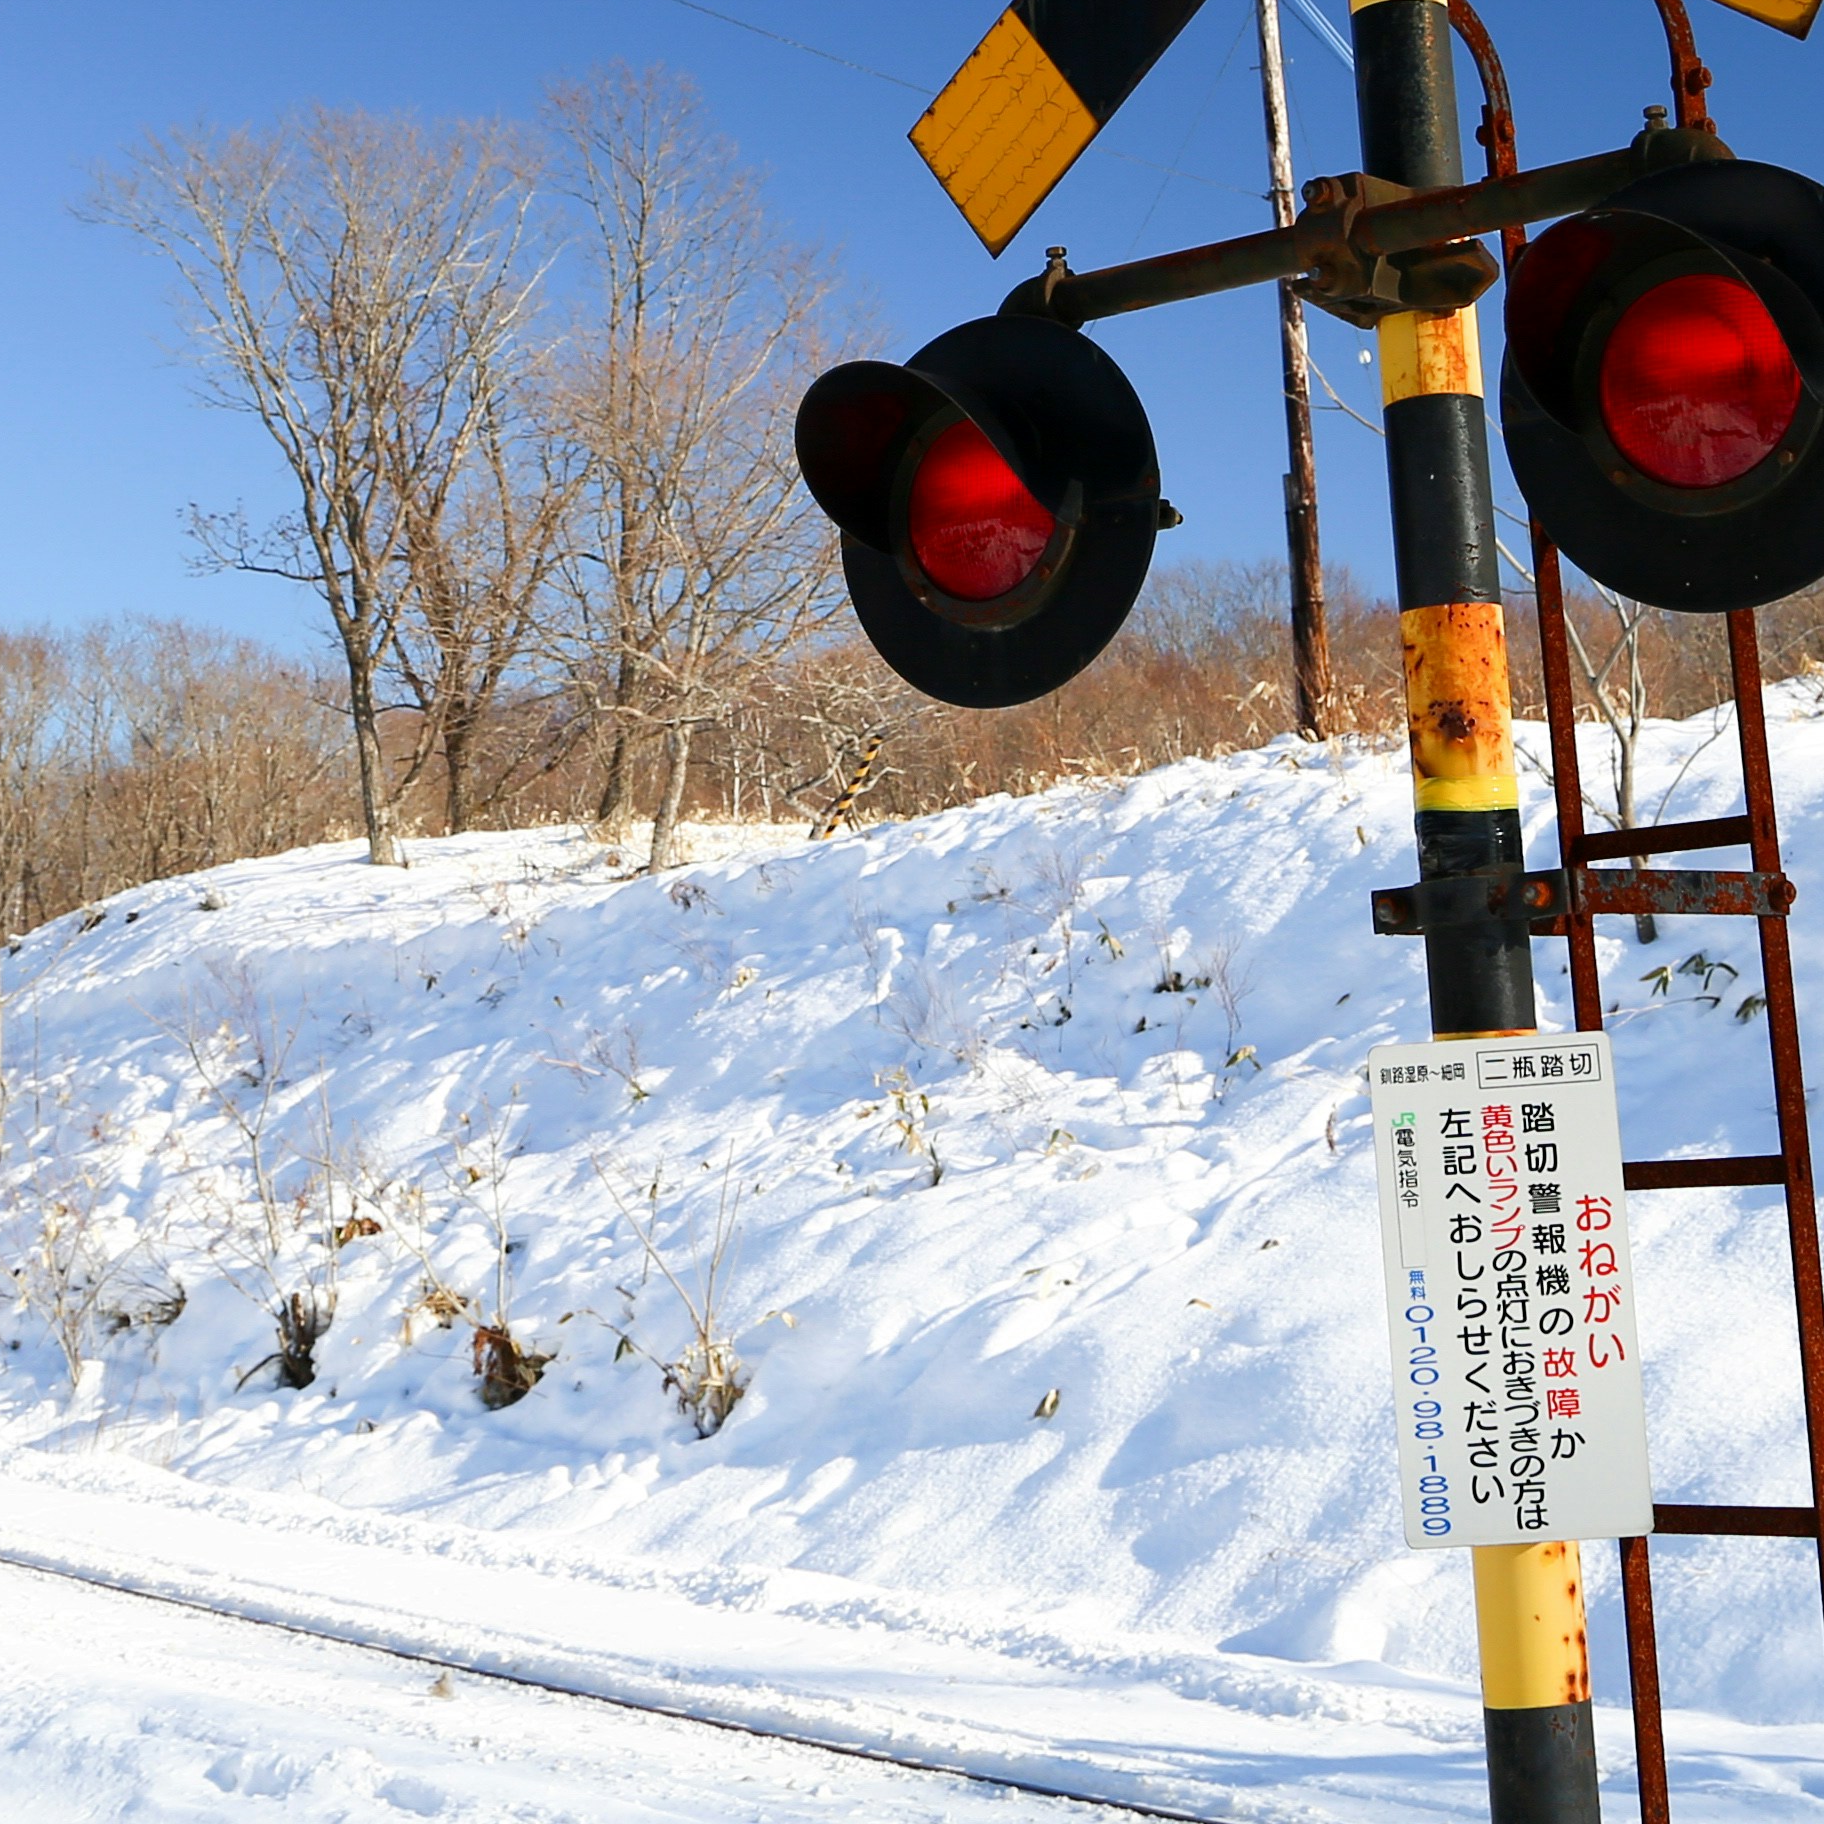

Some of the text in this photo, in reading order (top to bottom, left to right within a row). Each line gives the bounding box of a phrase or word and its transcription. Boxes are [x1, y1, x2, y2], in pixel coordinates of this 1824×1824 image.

[1484, 1052, 1592, 1080] 二瓶踏切
[1391, 1112, 1416, 1127] JR
[1394, 1128, 1420, 1209] 電気指令
[1408, 1270, 1426, 1300] 無料
[1439, 1108, 1505, 1504] 左記へおしらせください
[1521, 1101, 1585, 1459] 踏切警報機の故障か
[1575, 1193, 1625, 1368] おねがい
